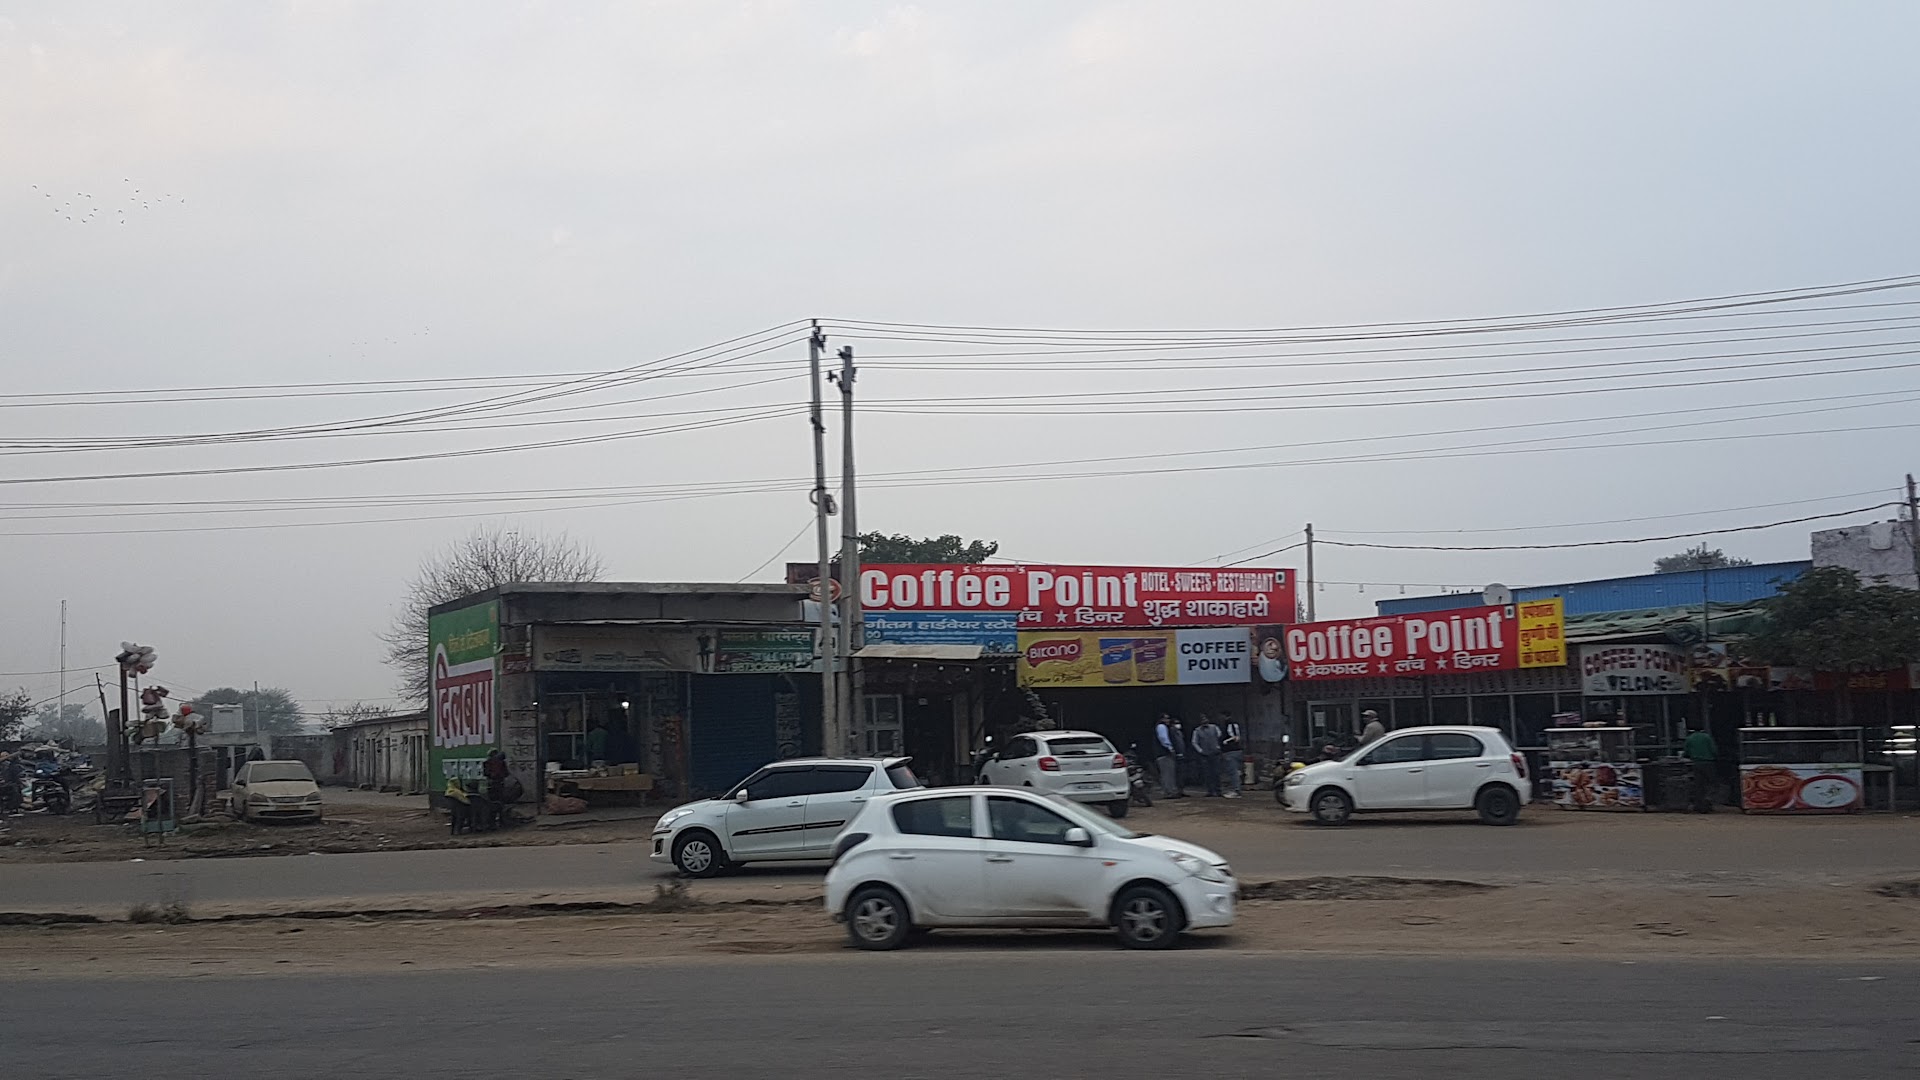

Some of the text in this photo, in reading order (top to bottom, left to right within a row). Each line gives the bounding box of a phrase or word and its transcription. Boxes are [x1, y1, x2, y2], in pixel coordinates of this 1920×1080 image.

[860, 569, 1138, 608] Coffee Point
[1141, 572, 1274, 593] HOTEL SWEETS RESTAURANT
[1073, 606, 1126, 625] डिनर
[1143, 593, 1270, 626] शुद्ध शाकाहारी
[1287, 624, 1394, 662] Coffee
[1405, 610, 1504, 655] Point
[1180, 641, 1247, 656] COFFEE
[1188, 658, 1241, 671] POINT
[1393, 655, 1427, 673] लंच
[1452, 650, 1501, 669] डिनर
